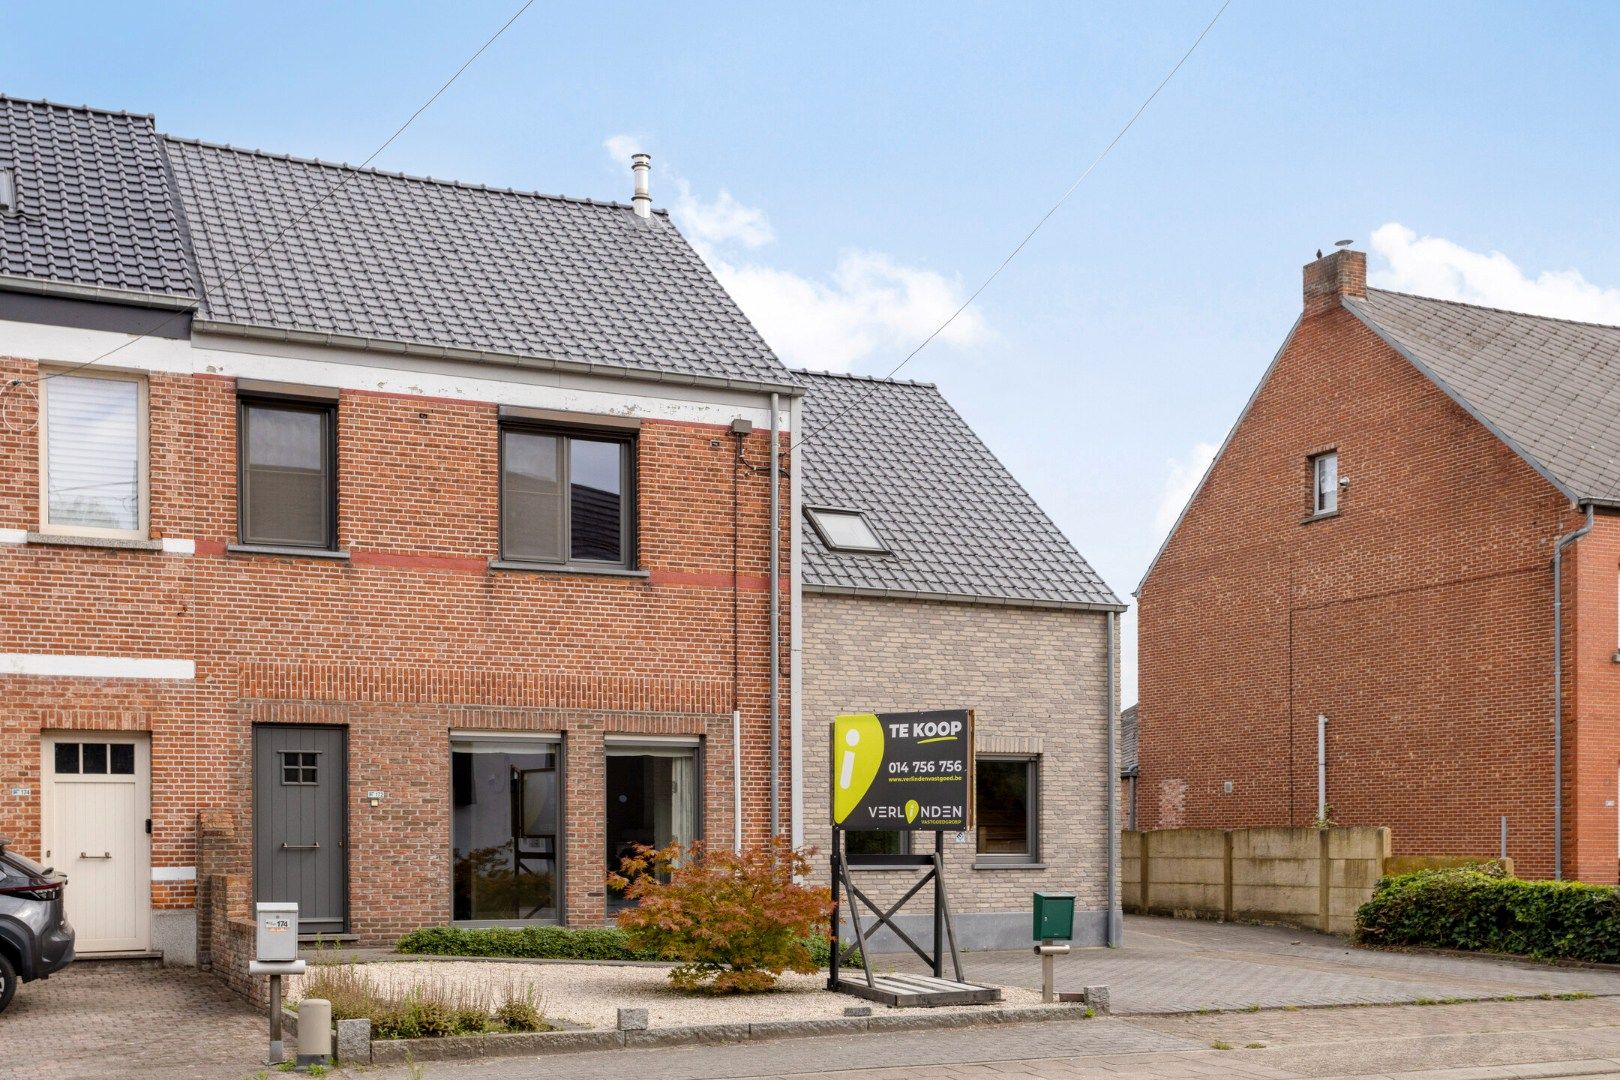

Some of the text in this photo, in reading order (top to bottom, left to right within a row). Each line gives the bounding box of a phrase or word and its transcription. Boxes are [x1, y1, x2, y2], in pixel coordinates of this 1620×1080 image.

[889, 721, 962, 738] TE KOOP
[888, 760, 962, 774] 014 756 756
[888, 775, 962, 783] www.verlindenvastgoed.be
[276, 920, 288, 928] 174
